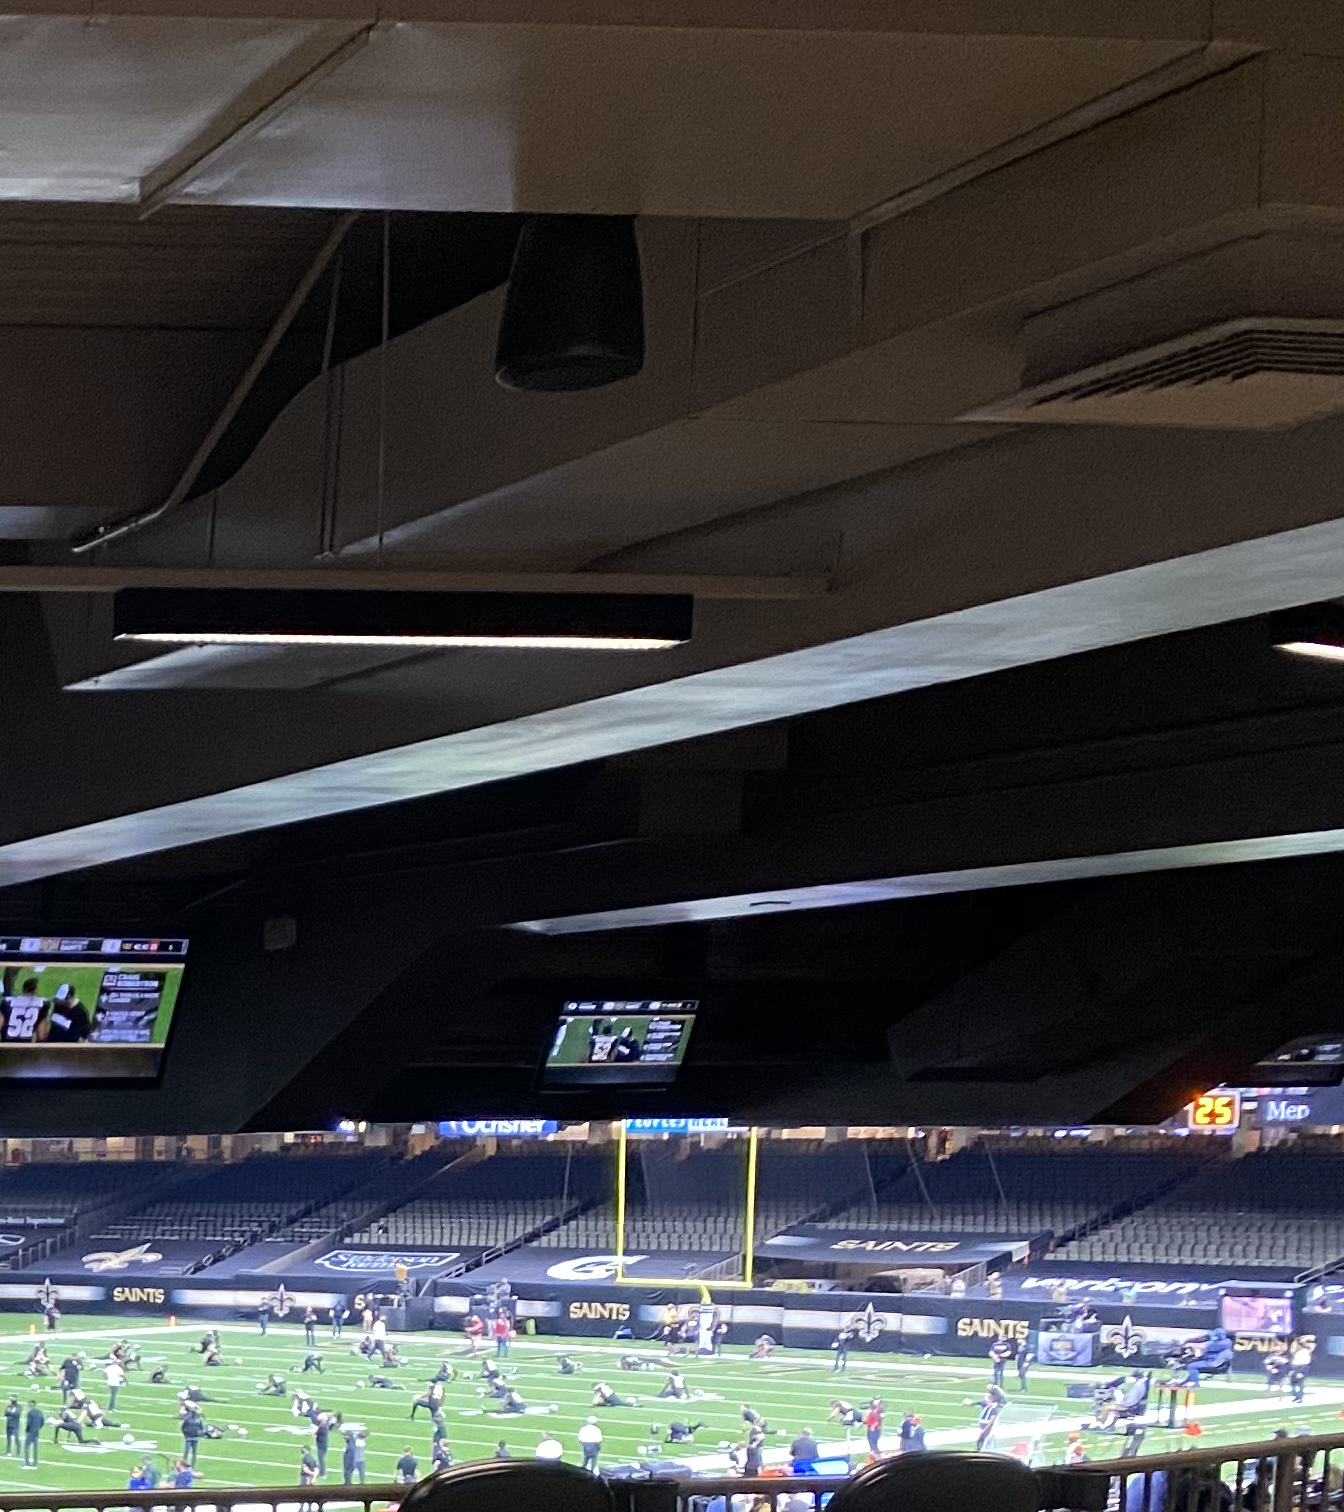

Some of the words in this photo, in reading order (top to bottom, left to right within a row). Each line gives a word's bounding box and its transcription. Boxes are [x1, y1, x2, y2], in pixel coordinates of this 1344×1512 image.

[7, 1007, 39, 1038] 52
[1195, 1097, 1232, 1125] 25
[830, 1239, 961, 1251] SAINTS
[113, 1287, 165, 1304] SAINTS
[569, 1302, 631, 1320] SAINTS
[957, 1317, 1030, 1339] SAINTS
